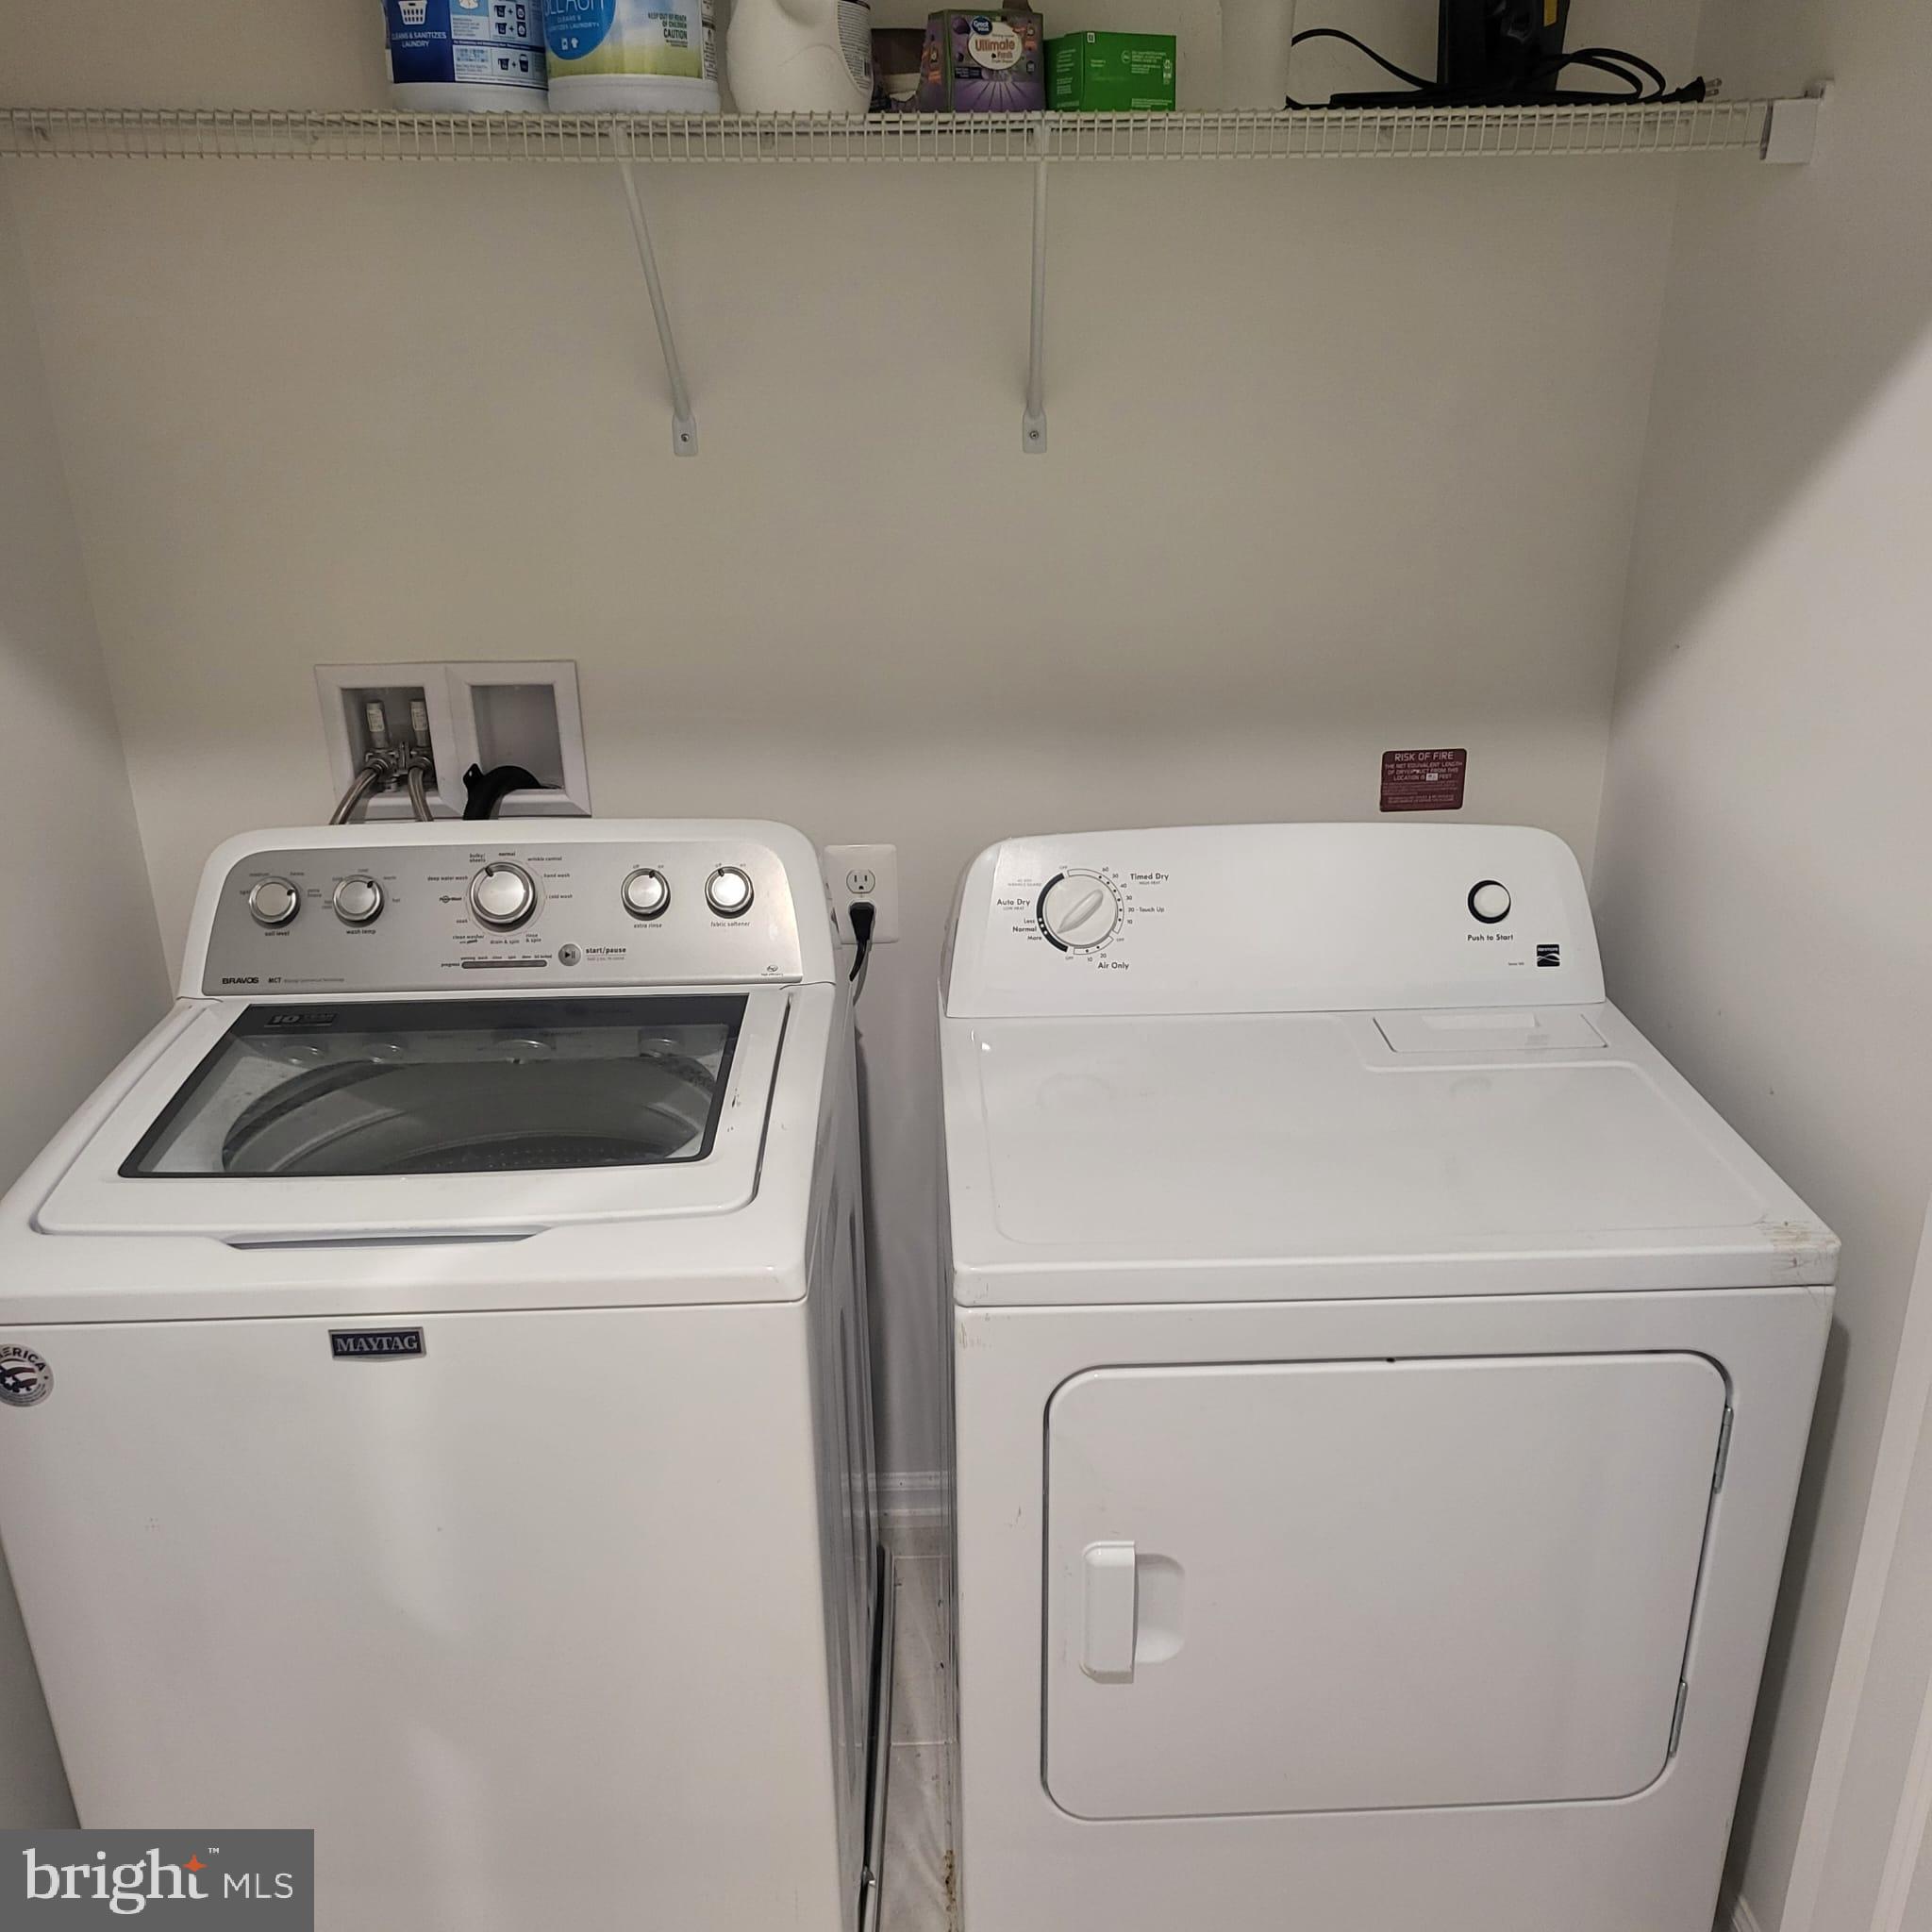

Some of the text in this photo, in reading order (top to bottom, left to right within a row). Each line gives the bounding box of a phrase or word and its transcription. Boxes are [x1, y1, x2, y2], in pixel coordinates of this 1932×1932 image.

[663, 28, 688, 40] CAUTION
[975, 39, 1015, 51] Ultimate
[1394, 751, 1454, 762] RISK OF FIRE
[1156, 874, 1169, 882] Dry
[1016, 898, 1031, 907] Dry
[586, 946, 626, 956] start/pause
[1111, 962, 1129, 971] Only
[335, 1336, 418, 1352] MAYTAG
[0, 1346, 46, 1372] ERICA
